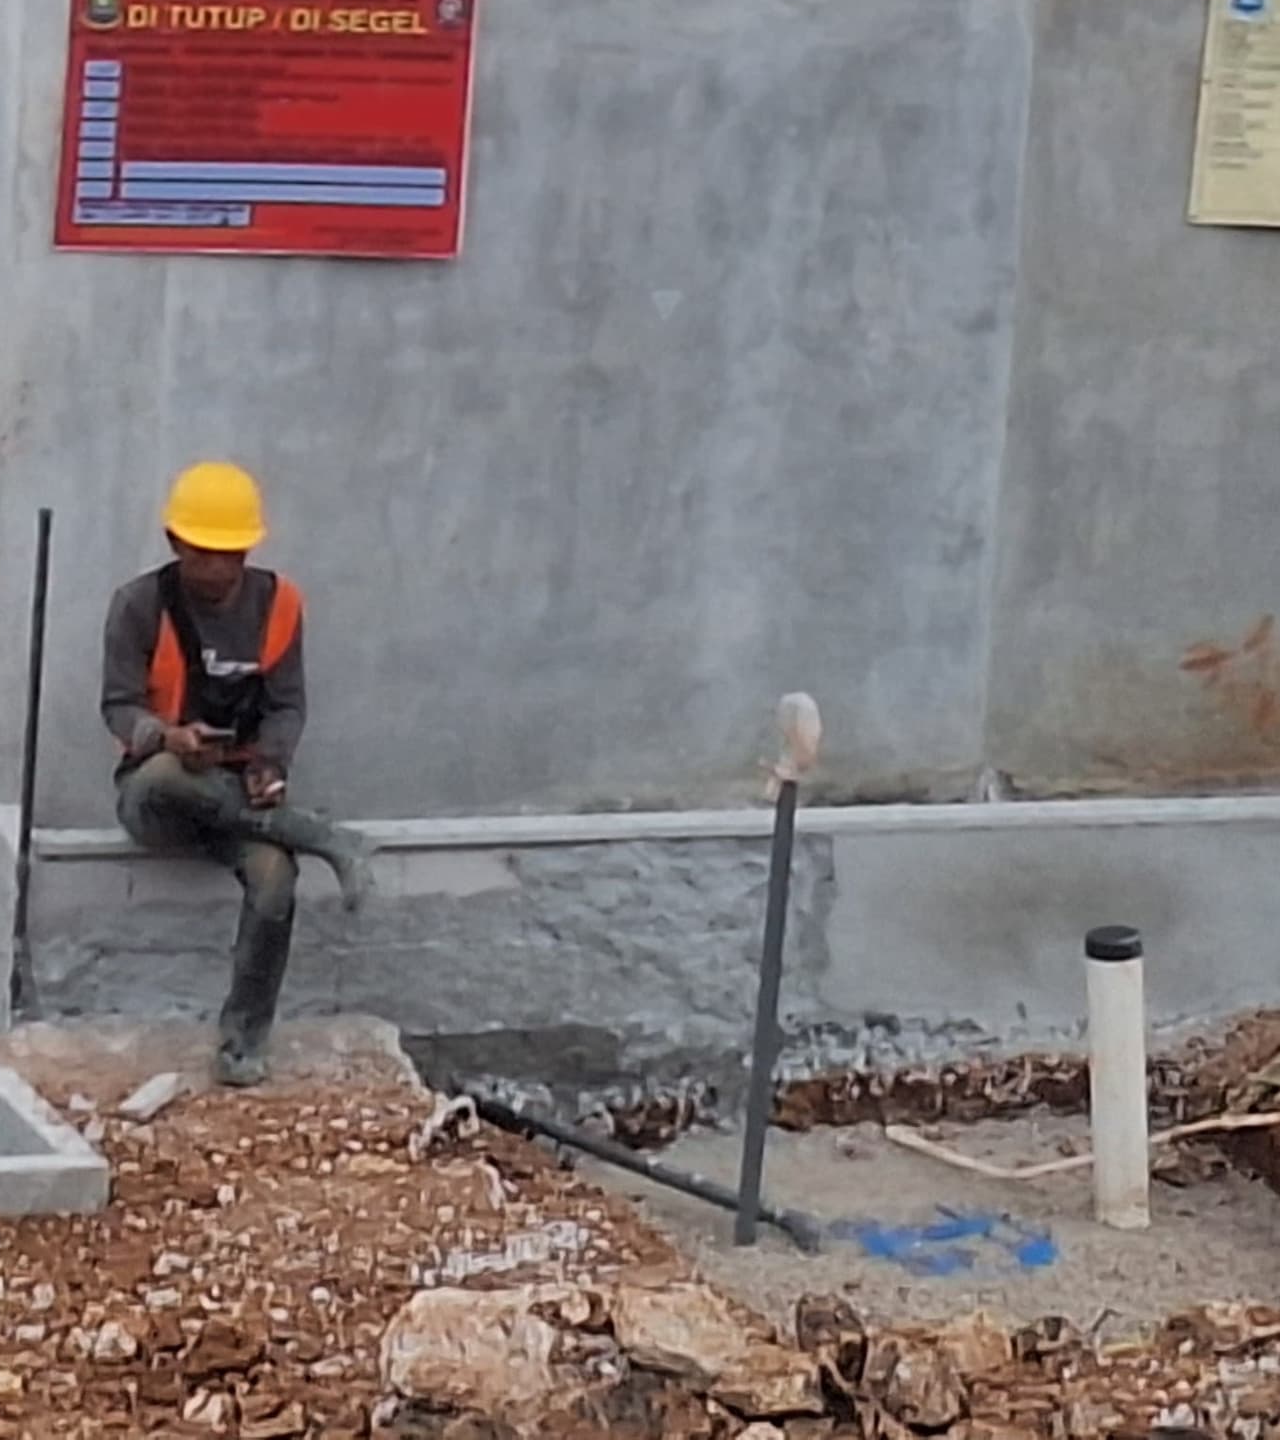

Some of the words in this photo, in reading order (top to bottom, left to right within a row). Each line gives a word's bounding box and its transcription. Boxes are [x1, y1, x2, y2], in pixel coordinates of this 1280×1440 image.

[127, 4, 157, 28] DI
[167, 5, 266, 30] TUTUP
[272, 10, 282, 31] /
[289, 8, 319, 31] DI
[328, 10, 428, 34] SEGEL
